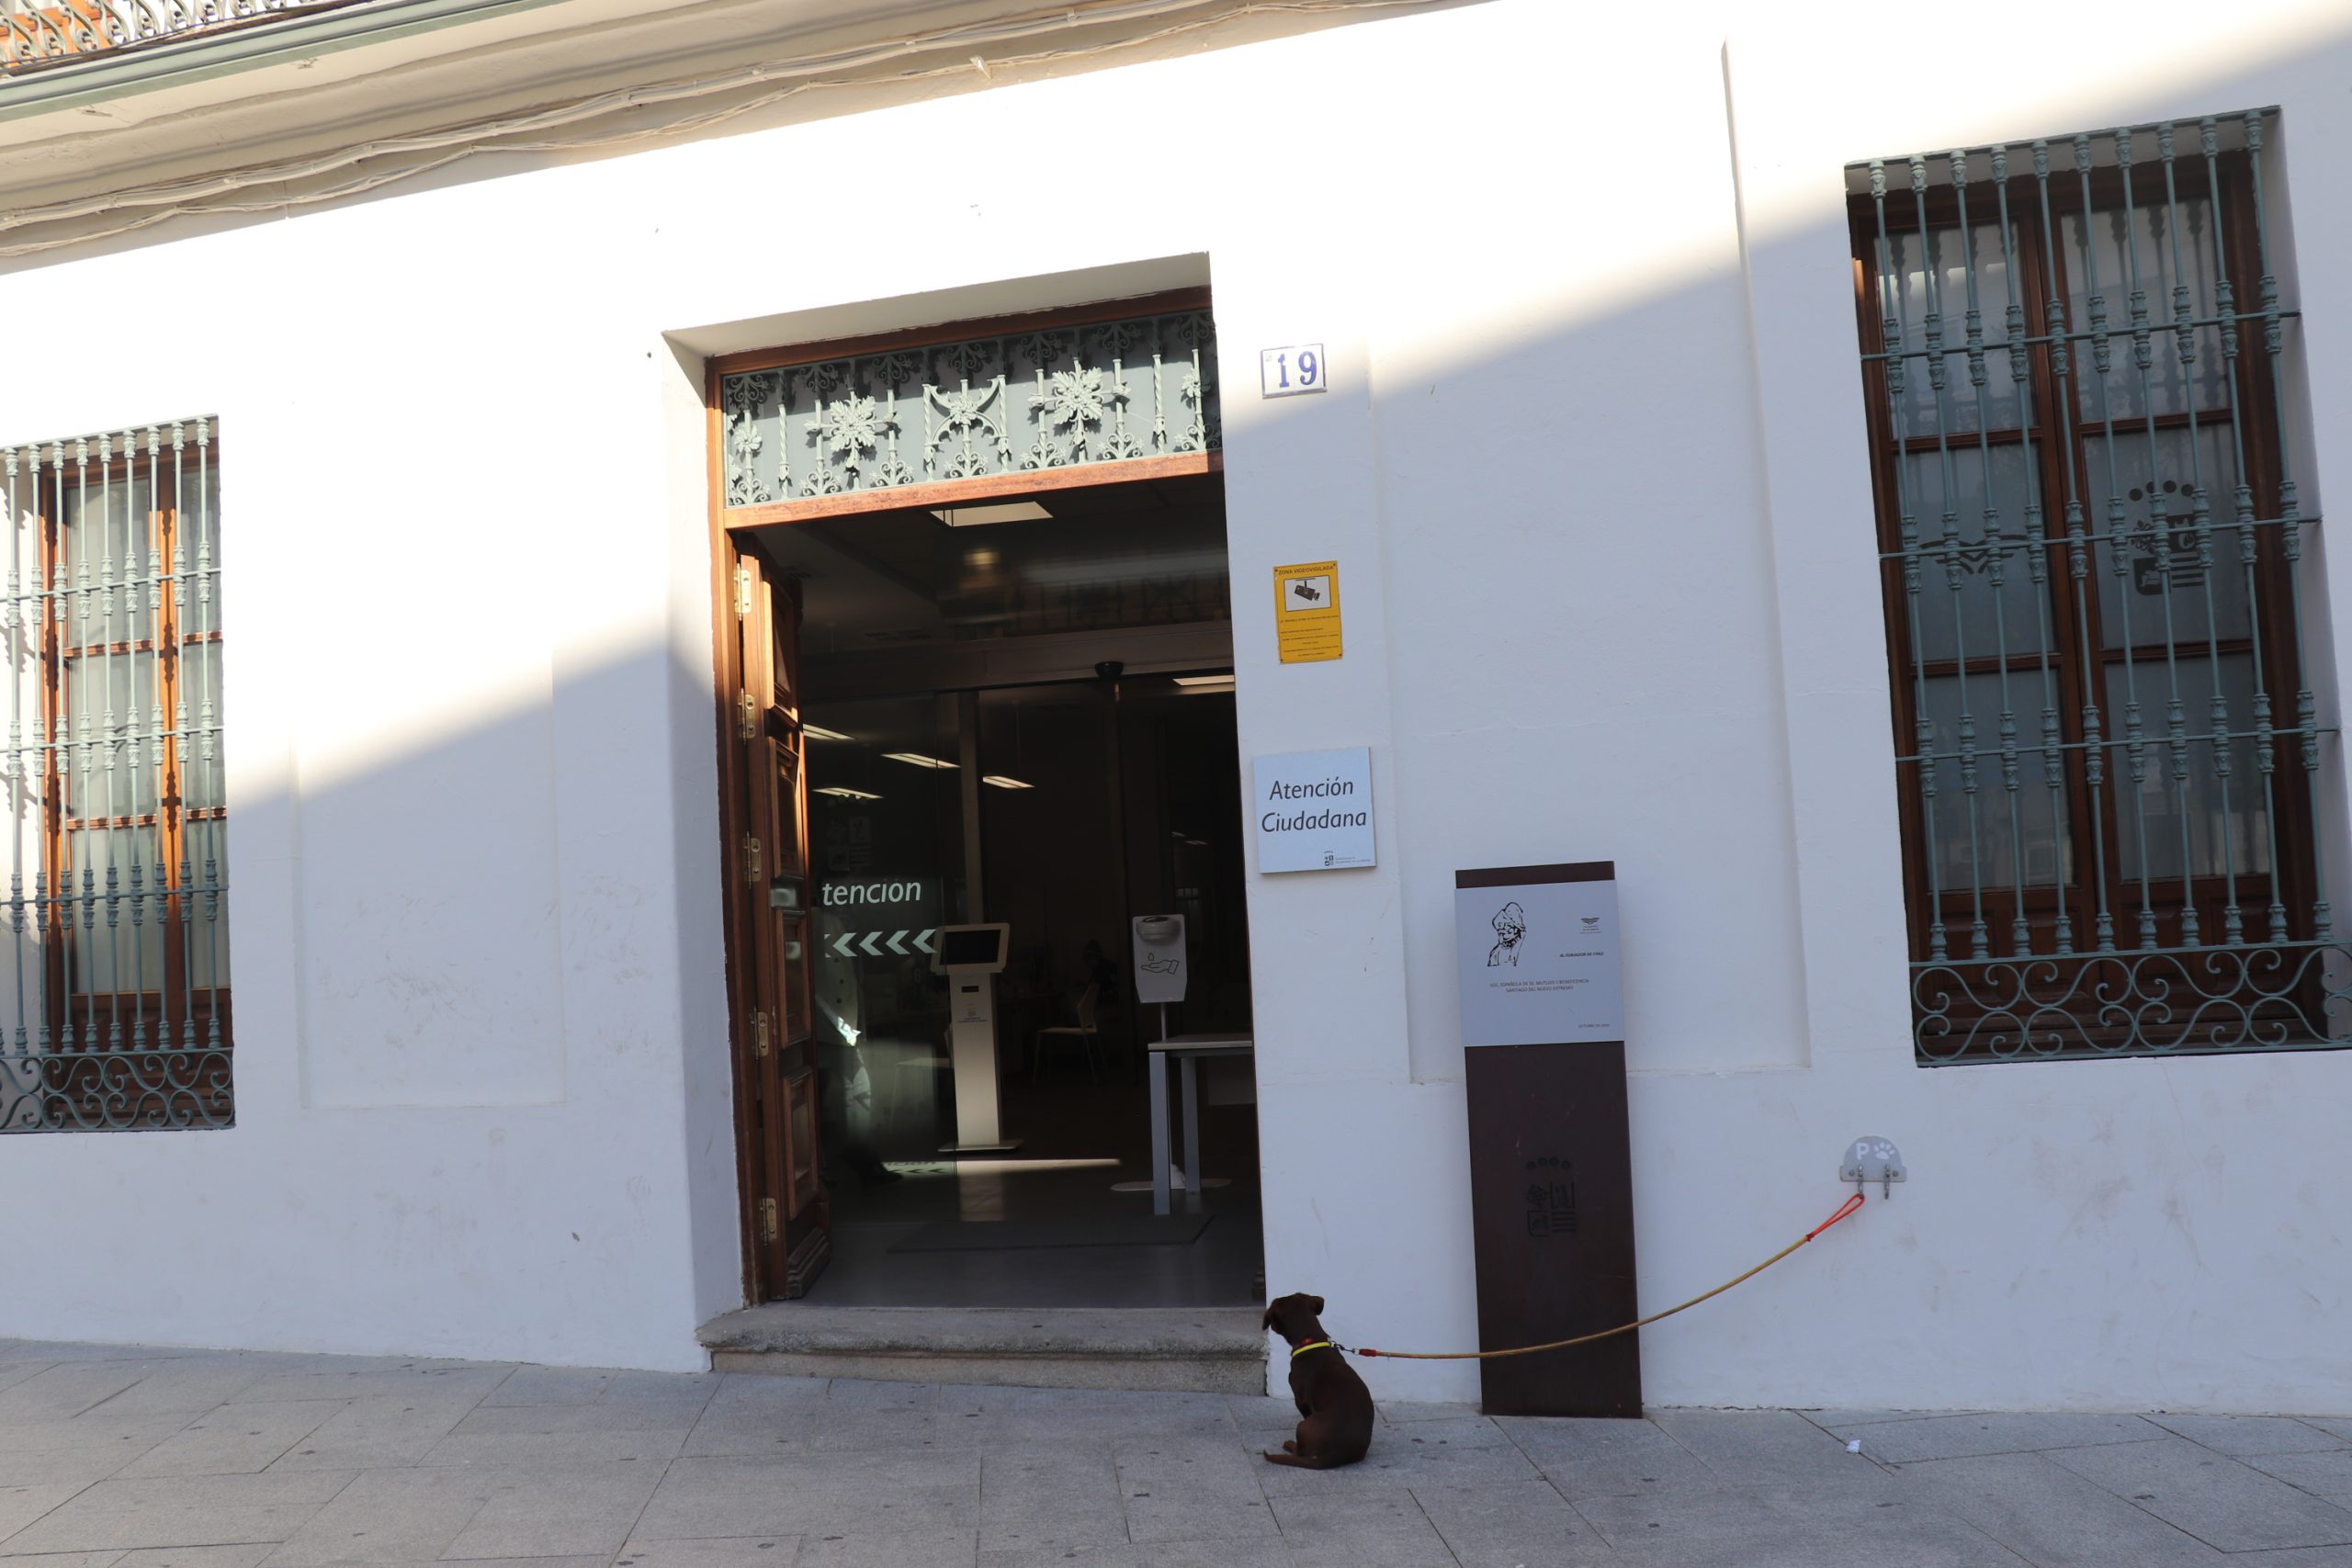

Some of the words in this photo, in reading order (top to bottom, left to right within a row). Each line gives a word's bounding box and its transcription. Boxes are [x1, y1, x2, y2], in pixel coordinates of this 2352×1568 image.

[1277, 351, 1317, 388] 19
[1269, 776, 1354, 801] Atención
[1261, 808, 1367, 833] Ciudadana
[1856, 1142, 1870, 1160] P
